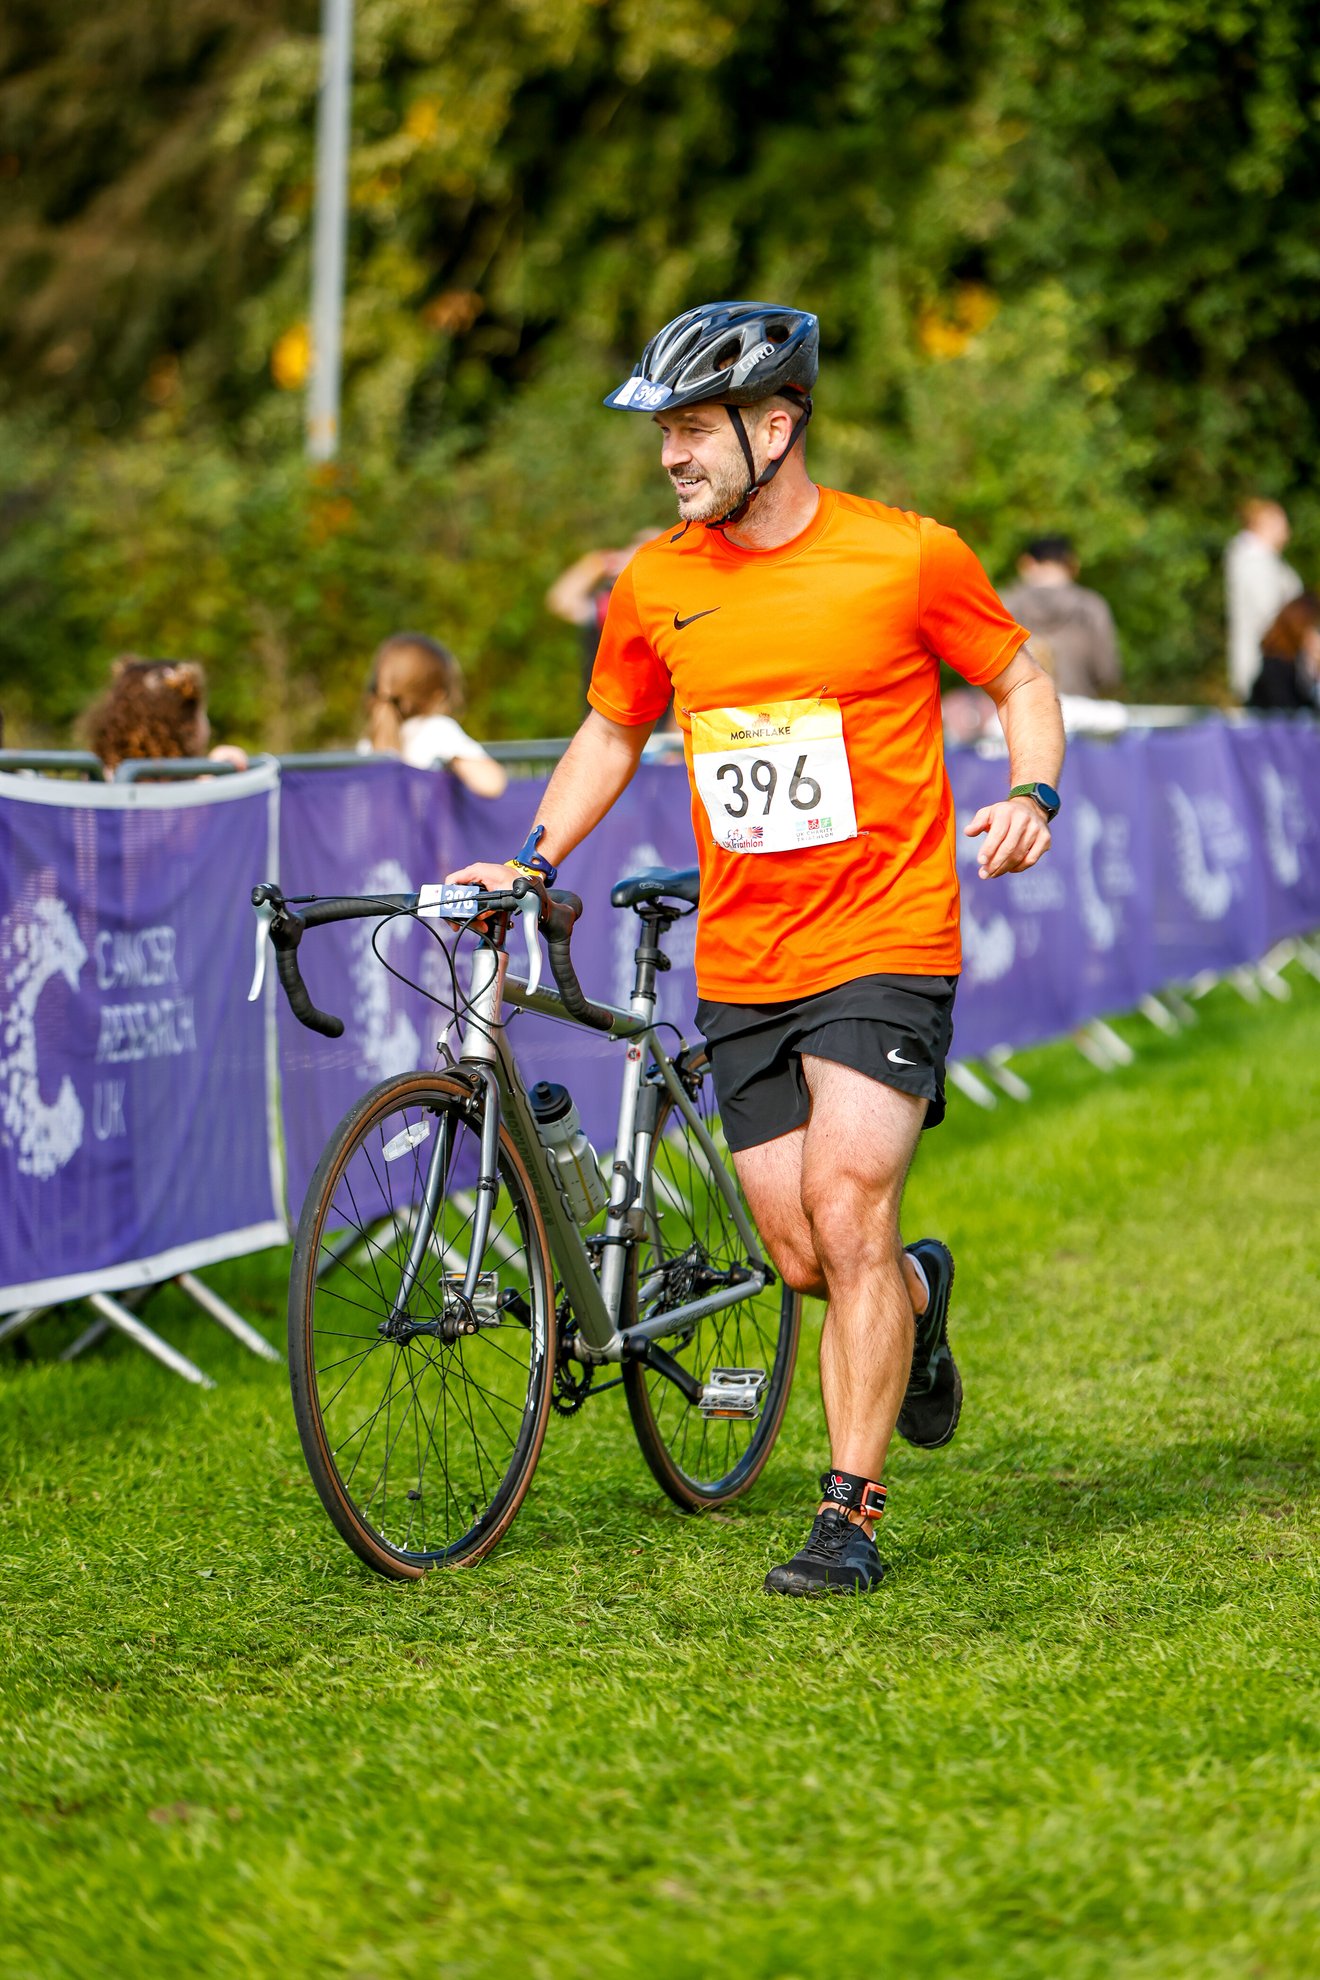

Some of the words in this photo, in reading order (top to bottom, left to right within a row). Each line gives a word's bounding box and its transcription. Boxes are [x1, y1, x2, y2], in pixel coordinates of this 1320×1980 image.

[740, 343, 775, 372] GIRO
[634, 384, 665, 405] 396
[730, 726, 791, 741] MORNFLAKE
[716, 754, 822, 818] 396
[444, 889, 475, 910] 396
[96, 925, 179, 990] CANCER
[93, 1079, 127, 1141] UK
